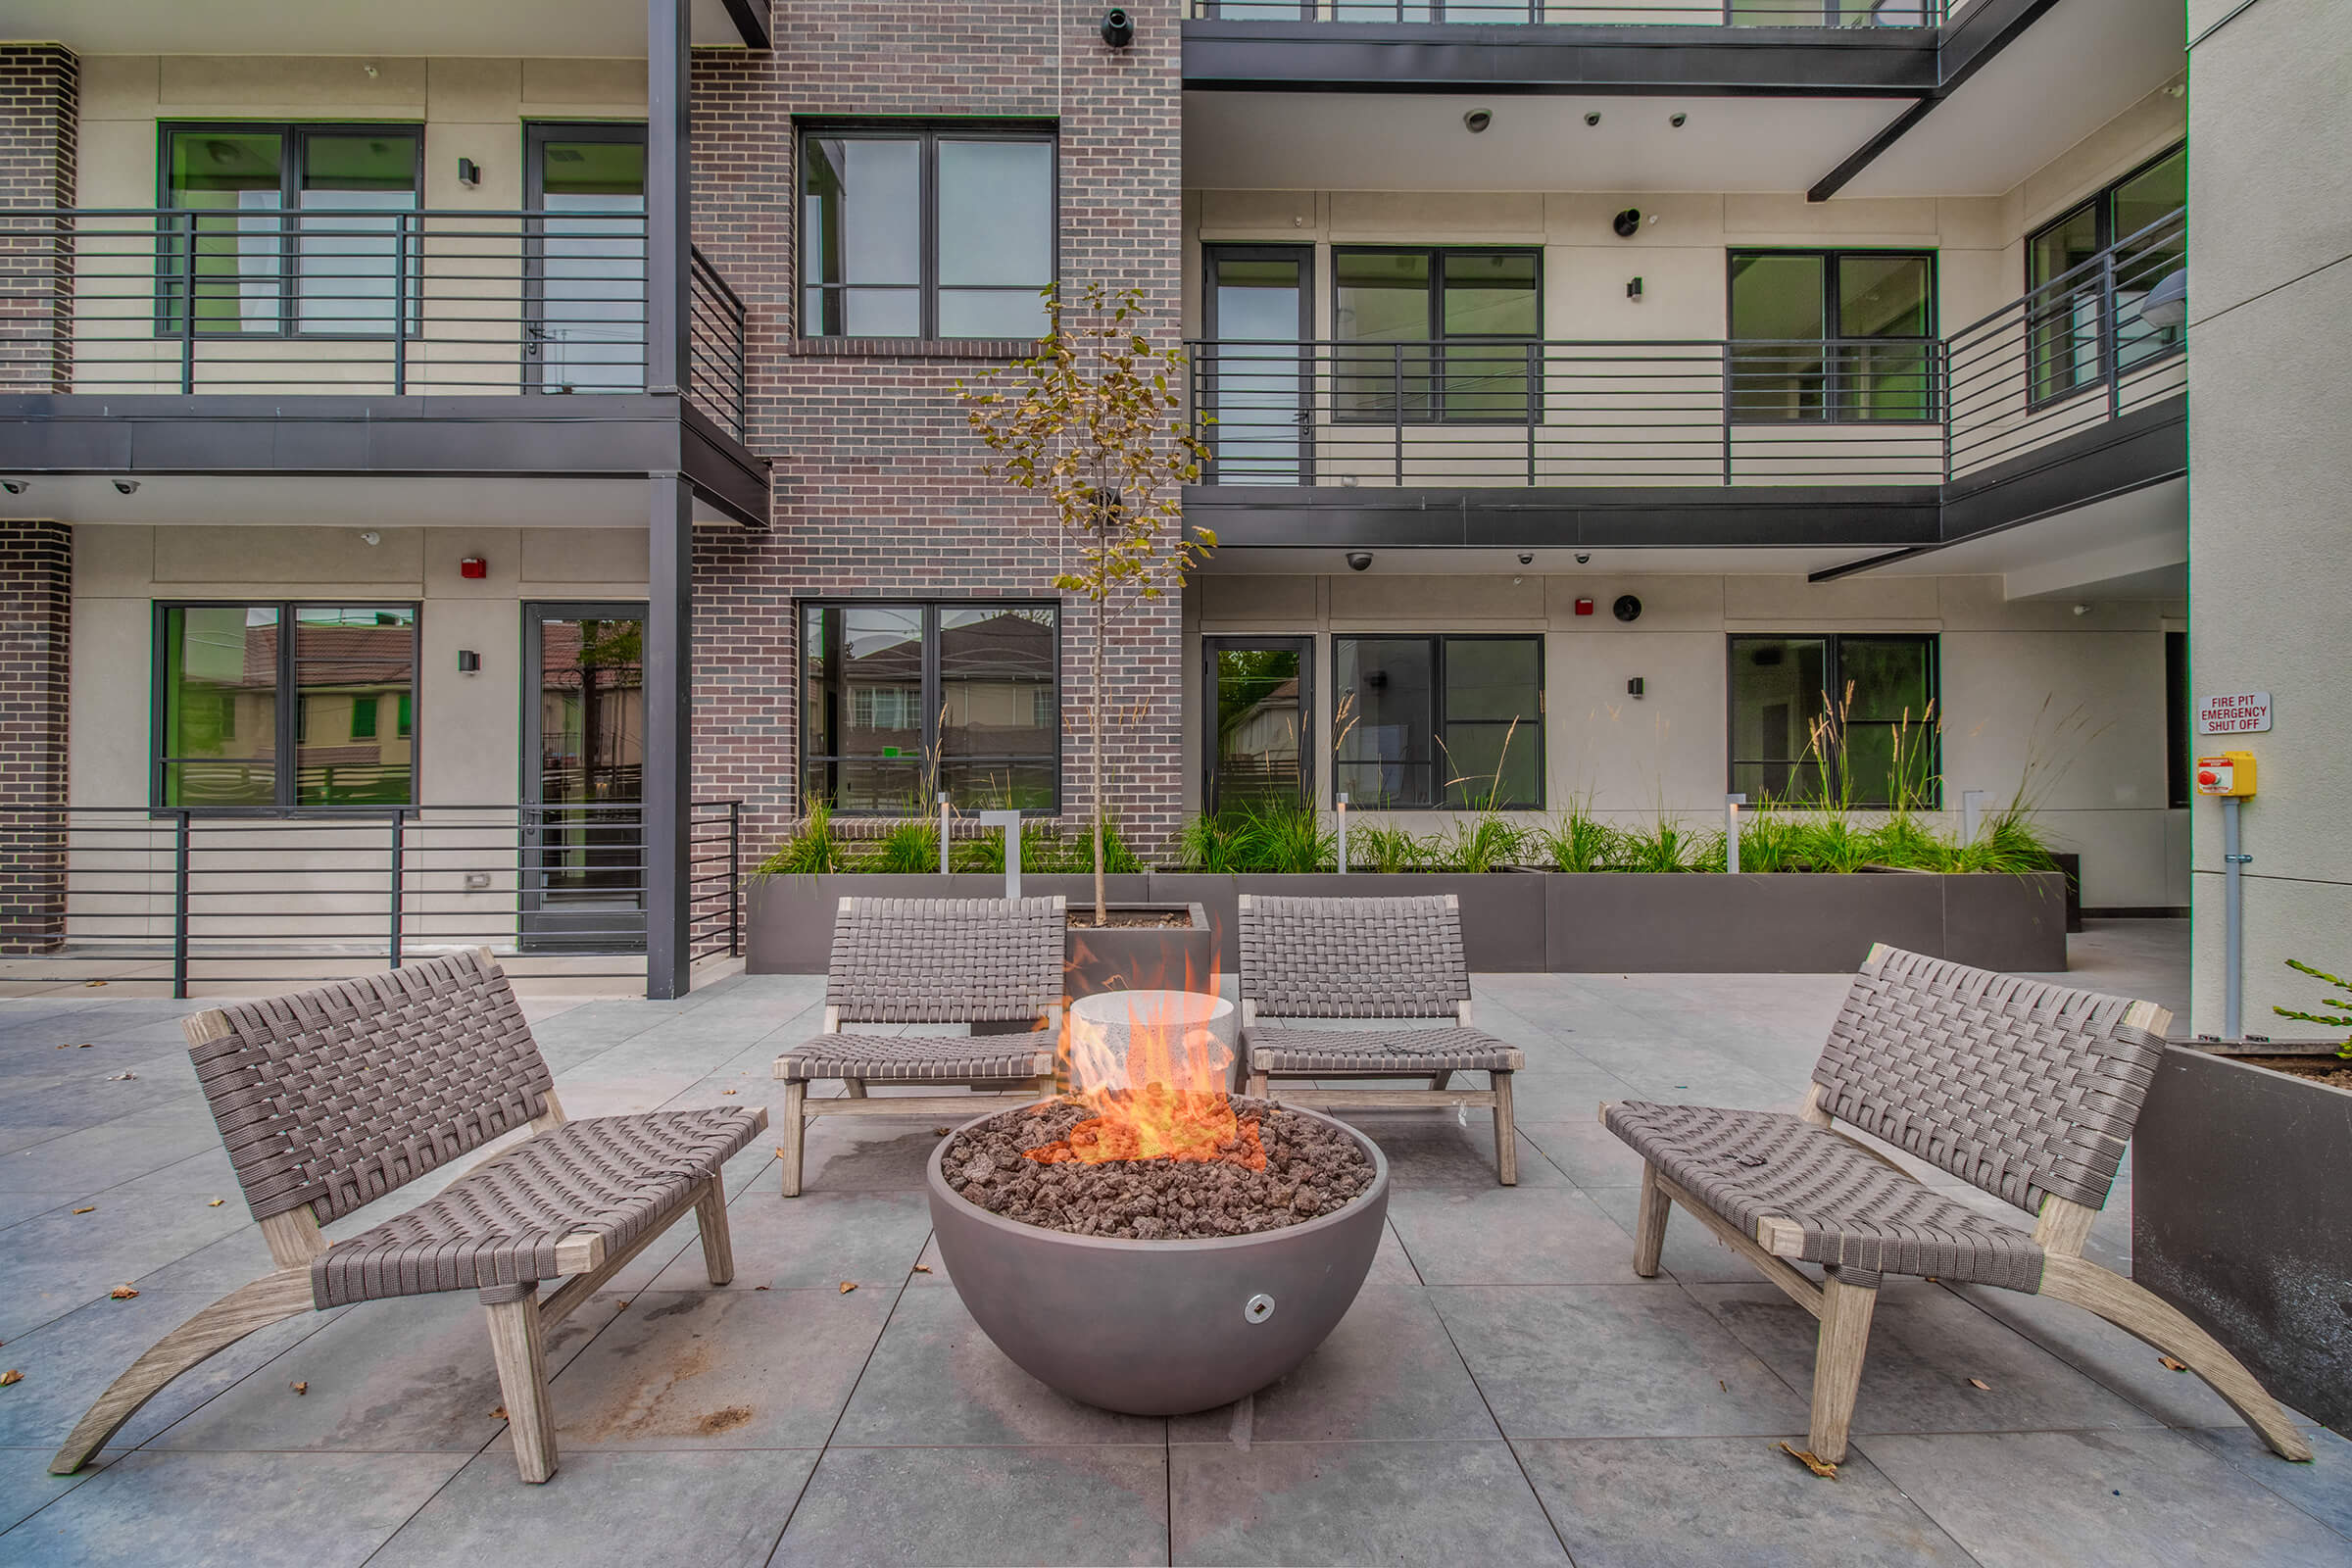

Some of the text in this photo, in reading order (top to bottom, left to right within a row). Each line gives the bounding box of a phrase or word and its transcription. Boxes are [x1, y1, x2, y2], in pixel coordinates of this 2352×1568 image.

[2212, 695, 2255, 708] FIRE PIT
[2202, 706, 2267, 720] EMERGENCY
[2208, 718, 2259, 731] SHUT OFF
